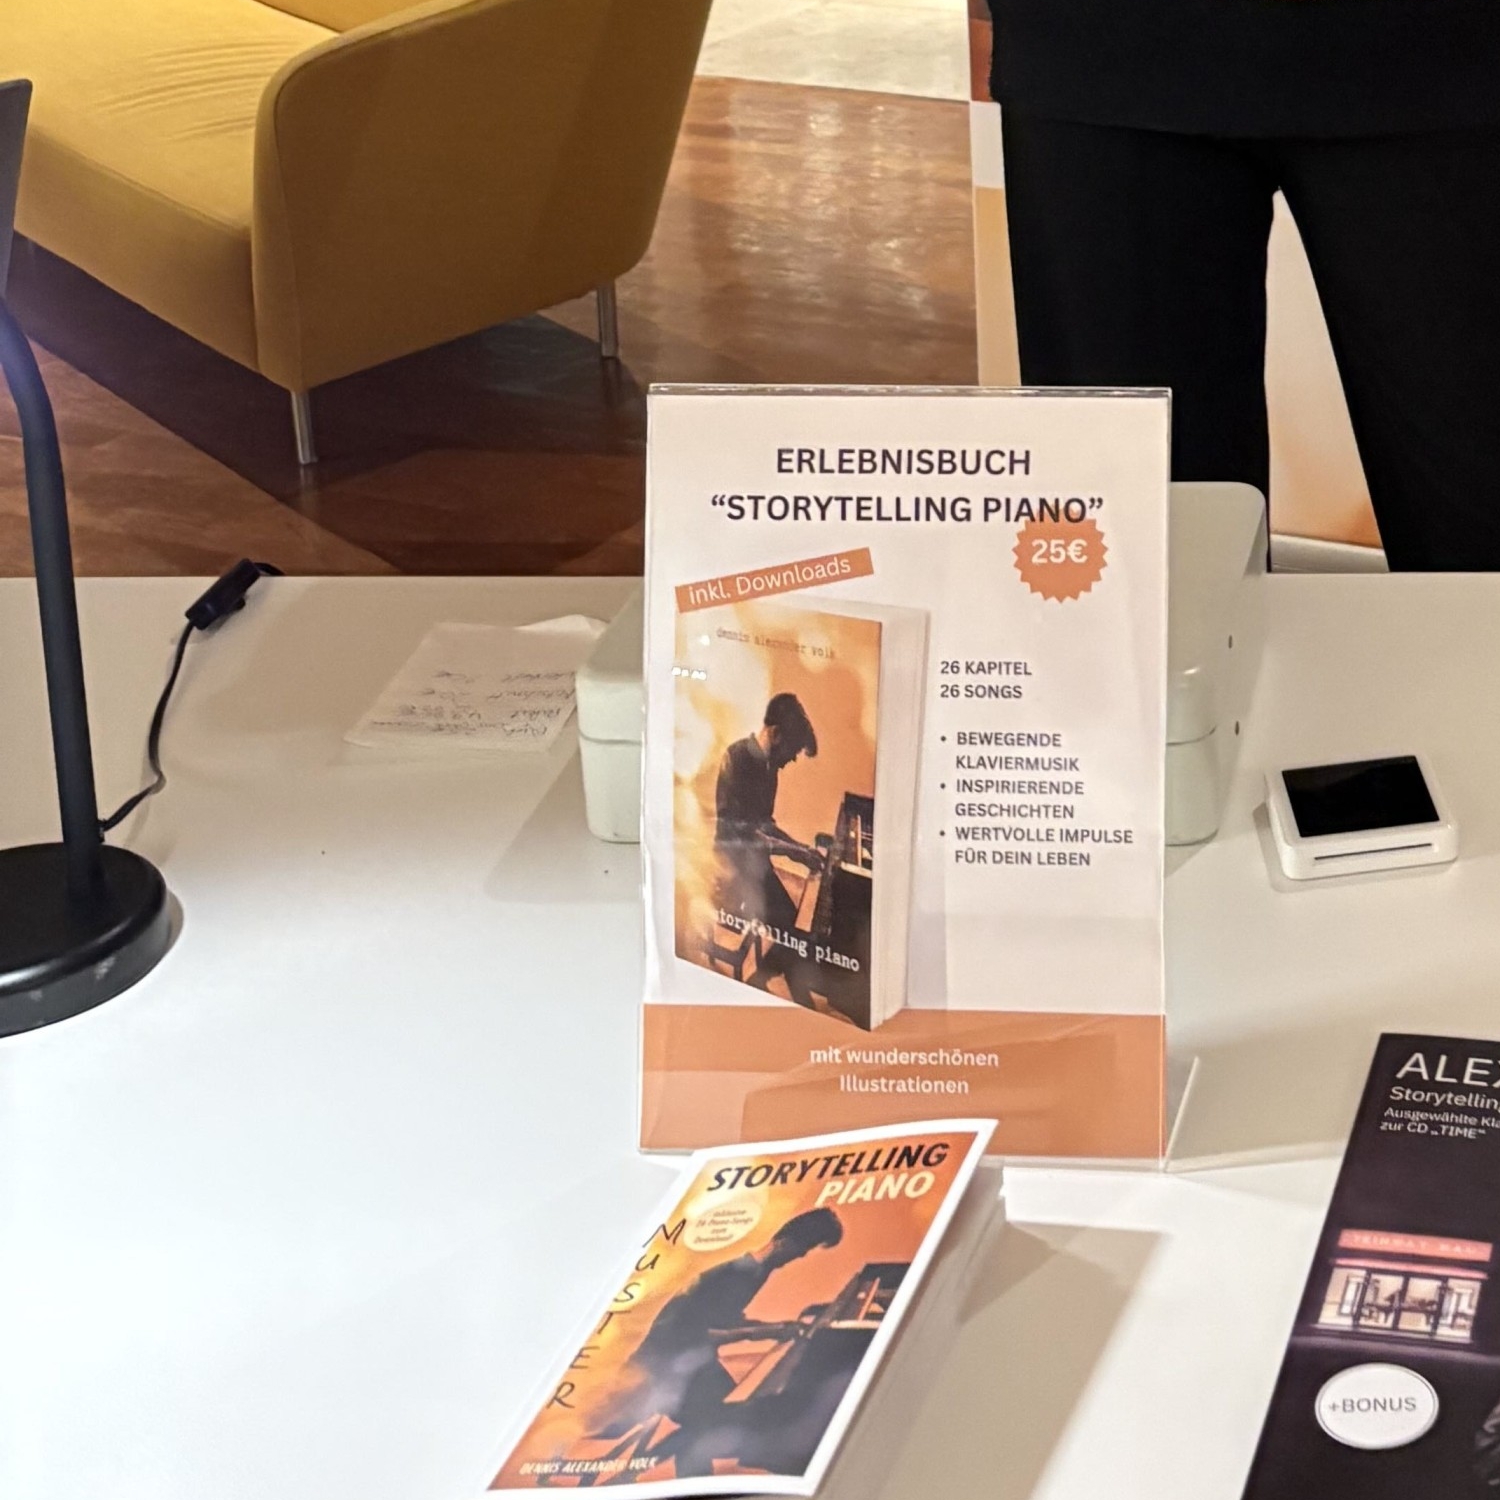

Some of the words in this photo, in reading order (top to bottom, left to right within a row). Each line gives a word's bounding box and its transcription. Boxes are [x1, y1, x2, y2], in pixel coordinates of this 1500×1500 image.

[776, 447, 1031, 476] ERLEBNISBUCH
[711, 494, 972, 524] “STORYTELLING
[983, 496, 1104, 525] PIANO”
[1030, 538, 1089, 565] 25€
[688, 578, 731, 606] inkl.
[735, 555, 852, 599] Downloads
[940, 660, 960, 675] 26
[964, 660, 1033, 677] KAPITEL
[940, 684, 960, 699] 26
[964, 684, 1023, 699] SONGS
[956, 731, 1062, 748] BEWEGENDE
[955, 755, 1080, 773] KLAVIERMUSIK
[956, 779, 1085, 796] INSPIRIERENDE
[954, 802, 1076, 820] GESCHICHTEN
[955, 826, 1056, 843] WERTVOLLE
[1059, 828, 1134, 844] IMPULSE
[954, 847, 988, 865] FÜR
[991, 850, 1033, 866] DEIN
[1036, 851, 1091, 867] LEBEN
[815, 945, 860, 972] piano
[810, 1046, 841, 1064] mit
[846, 1047, 1000, 1068] wunderschönen
[839, 1075, 969, 1095] Illustrationen
[1384, 1106, 1479, 1127] Ausgewählte
[1380, 1121, 1402, 1132] zur
[1406, 1121, 1429, 1134] CD
[707, 1142, 950, 1192] STORYTELLING
[815, 1170, 936, 1209] PIANO
[1329, 1397, 1417, 1413] +BONUS
